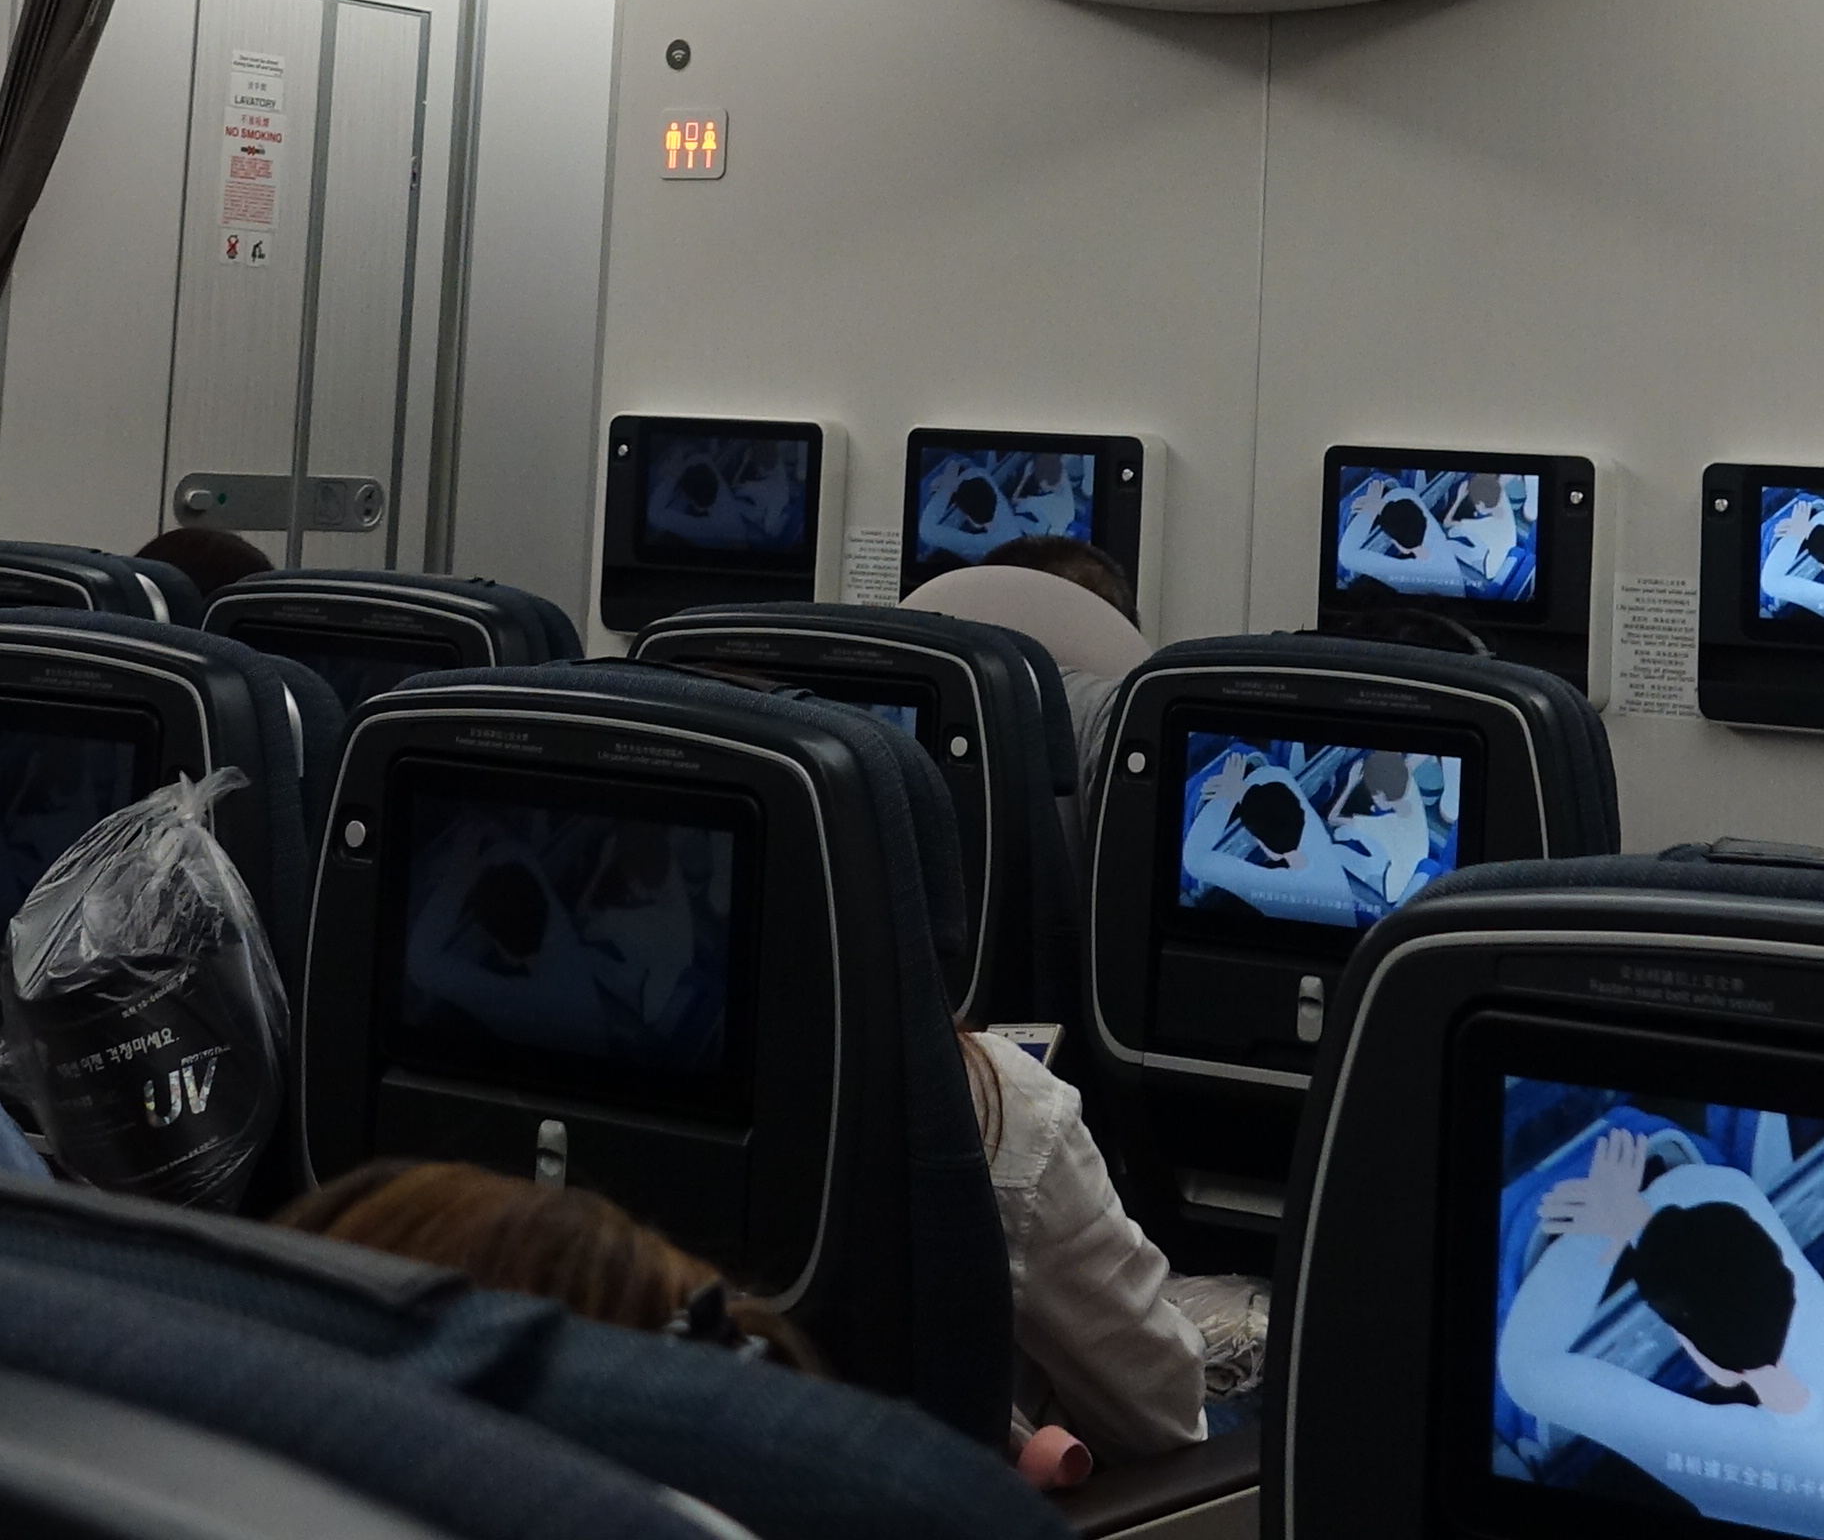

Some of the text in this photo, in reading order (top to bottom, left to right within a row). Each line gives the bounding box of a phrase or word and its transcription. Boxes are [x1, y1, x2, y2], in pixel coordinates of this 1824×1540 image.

[234, 95, 277, 108] LAVATORY
[225, 126, 282, 143] NO SMOKING
[106, 1027, 180, 1065] 걱정마세요.
[143, 1057, 218, 1128] UV
